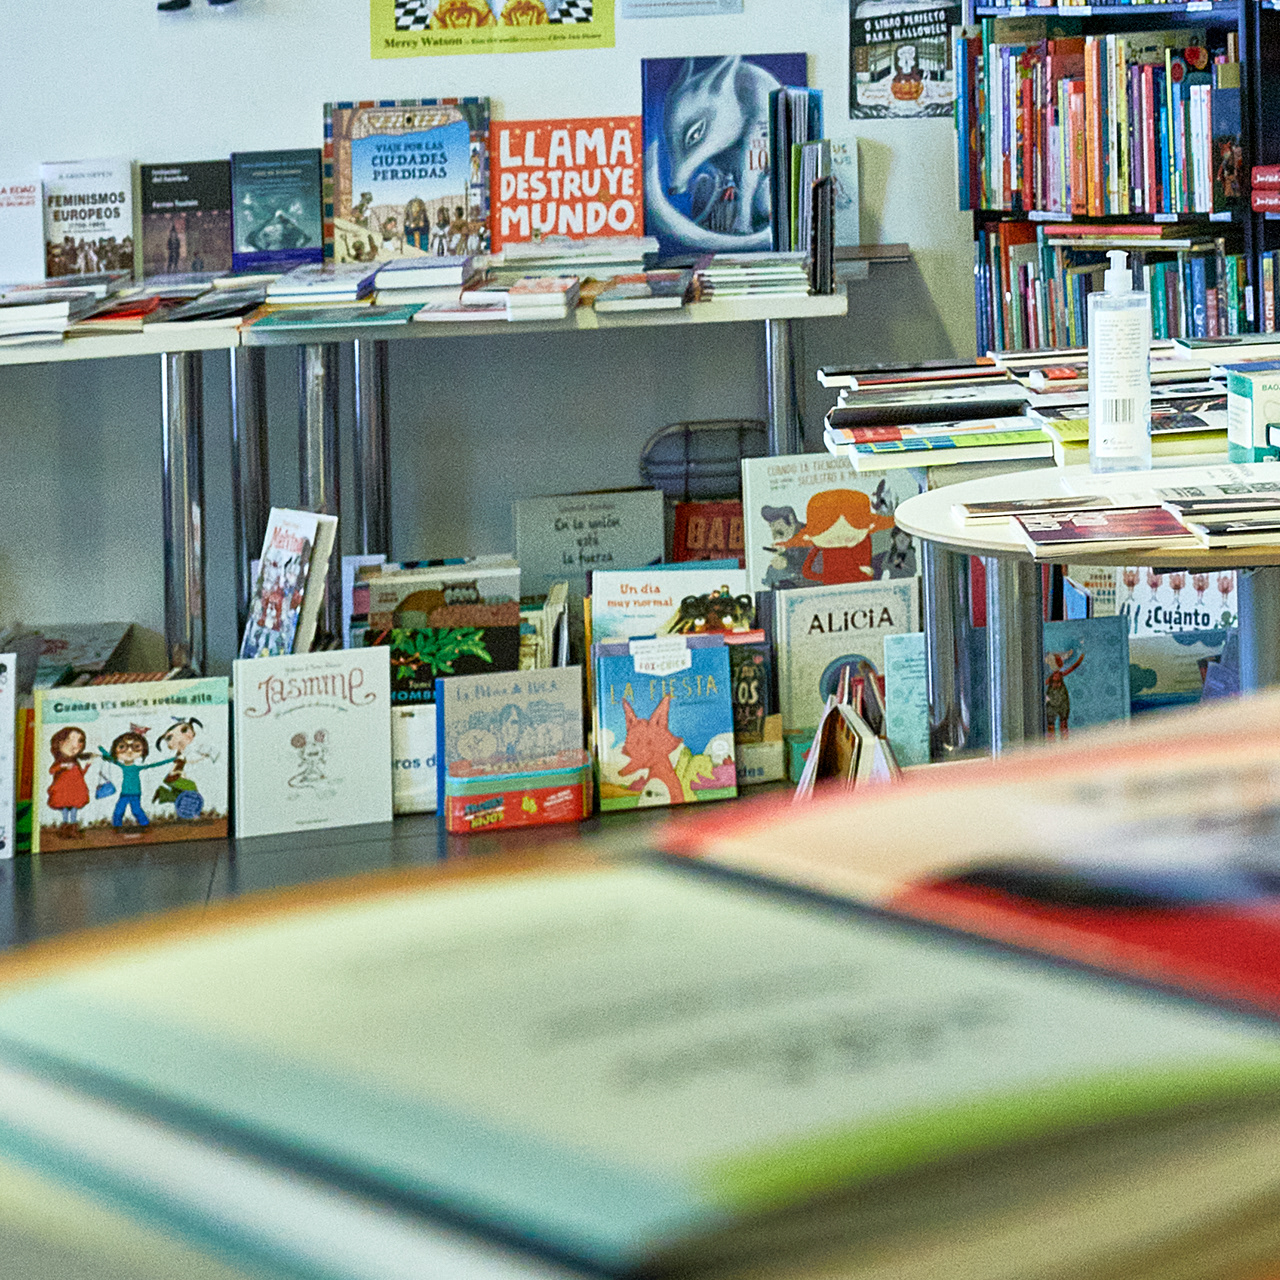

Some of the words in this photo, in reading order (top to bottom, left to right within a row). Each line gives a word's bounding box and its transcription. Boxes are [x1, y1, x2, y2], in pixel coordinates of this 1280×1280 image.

[384, 37, 418, 50] Mercy
[421, 36, 463, 48] Watson
[865, 31, 891, 44] PARA
[424, 140, 444, 151] LAS
[499, 128, 635, 168] LLAMA
[371, 152, 448, 168] CIUDADES
[500, 166, 635, 202] DESTRUYE
[47, 191, 126, 208] FEMINISMOS
[53, 206, 121, 222] EUROPEOS
[500, 199, 636, 236] MUNDO
[620, 583, 639, 595] Un
[607, 600, 630, 609] muy
[633, 597, 673, 608] normal
[1145, 604, 1210, 628] ¿Cuánto
[243, 667, 377, 719] Jasmine
[610, 682, 635, 705] LA
[650, 675, 718, 701] FIESTA
[53, 701, 97, 714] Cuando
